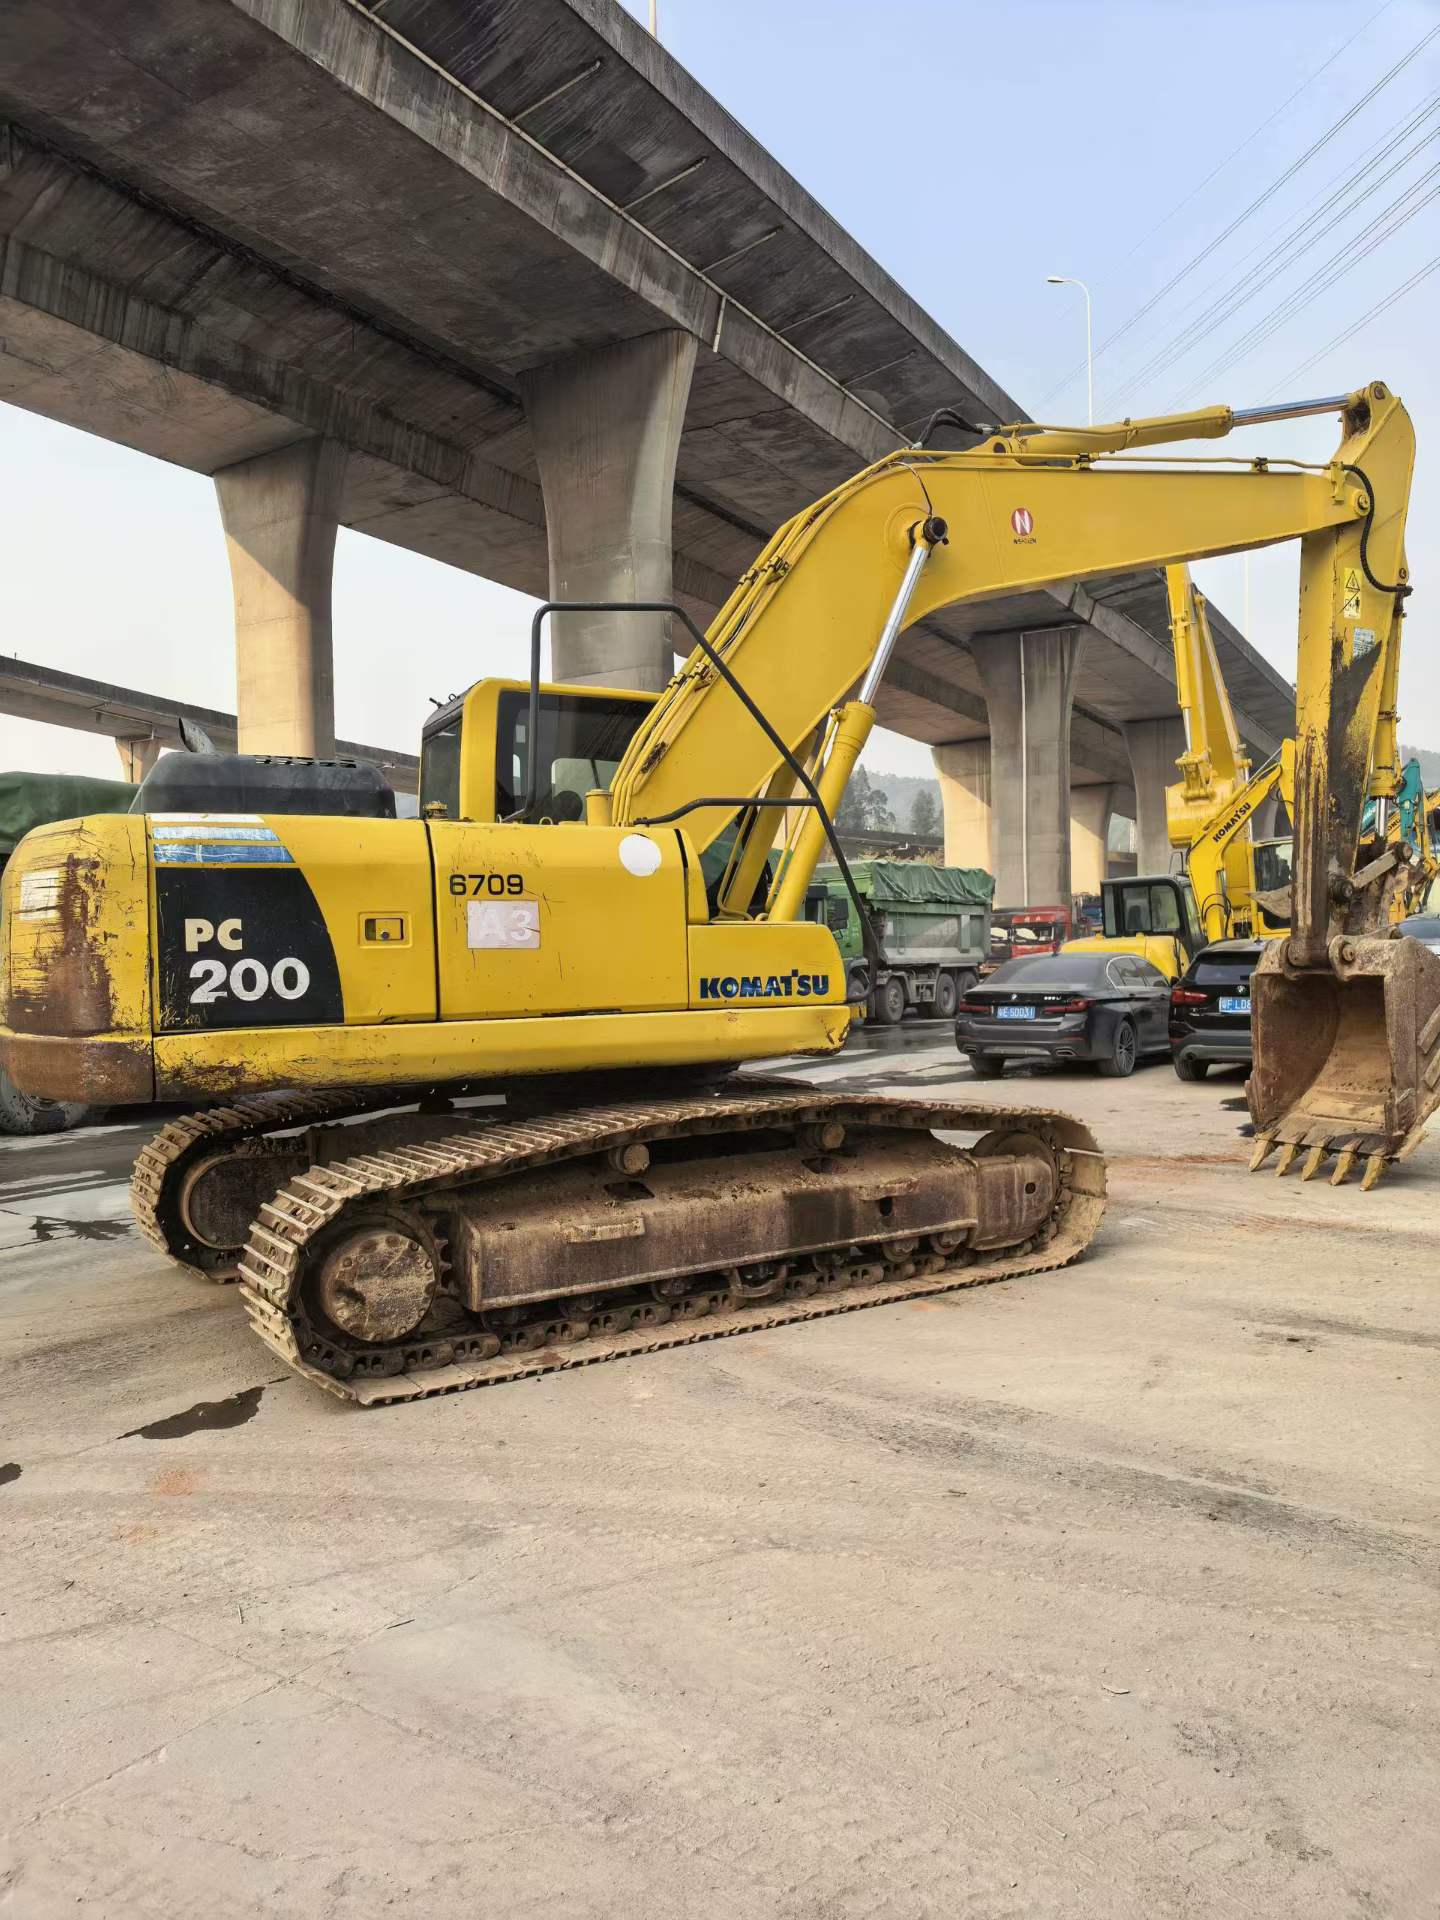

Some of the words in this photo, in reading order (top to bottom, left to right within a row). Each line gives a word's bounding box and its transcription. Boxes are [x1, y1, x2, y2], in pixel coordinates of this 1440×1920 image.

[1212, 802, 1251, 842] KOMATSU
[450, 873, 524, 896] 6709
[185, 918, 243, 952] PC
[478, 908, 533, 941] A3
[189, 957, 311, 1004] 200
[700, 969, 829, 999] KOMATSU
